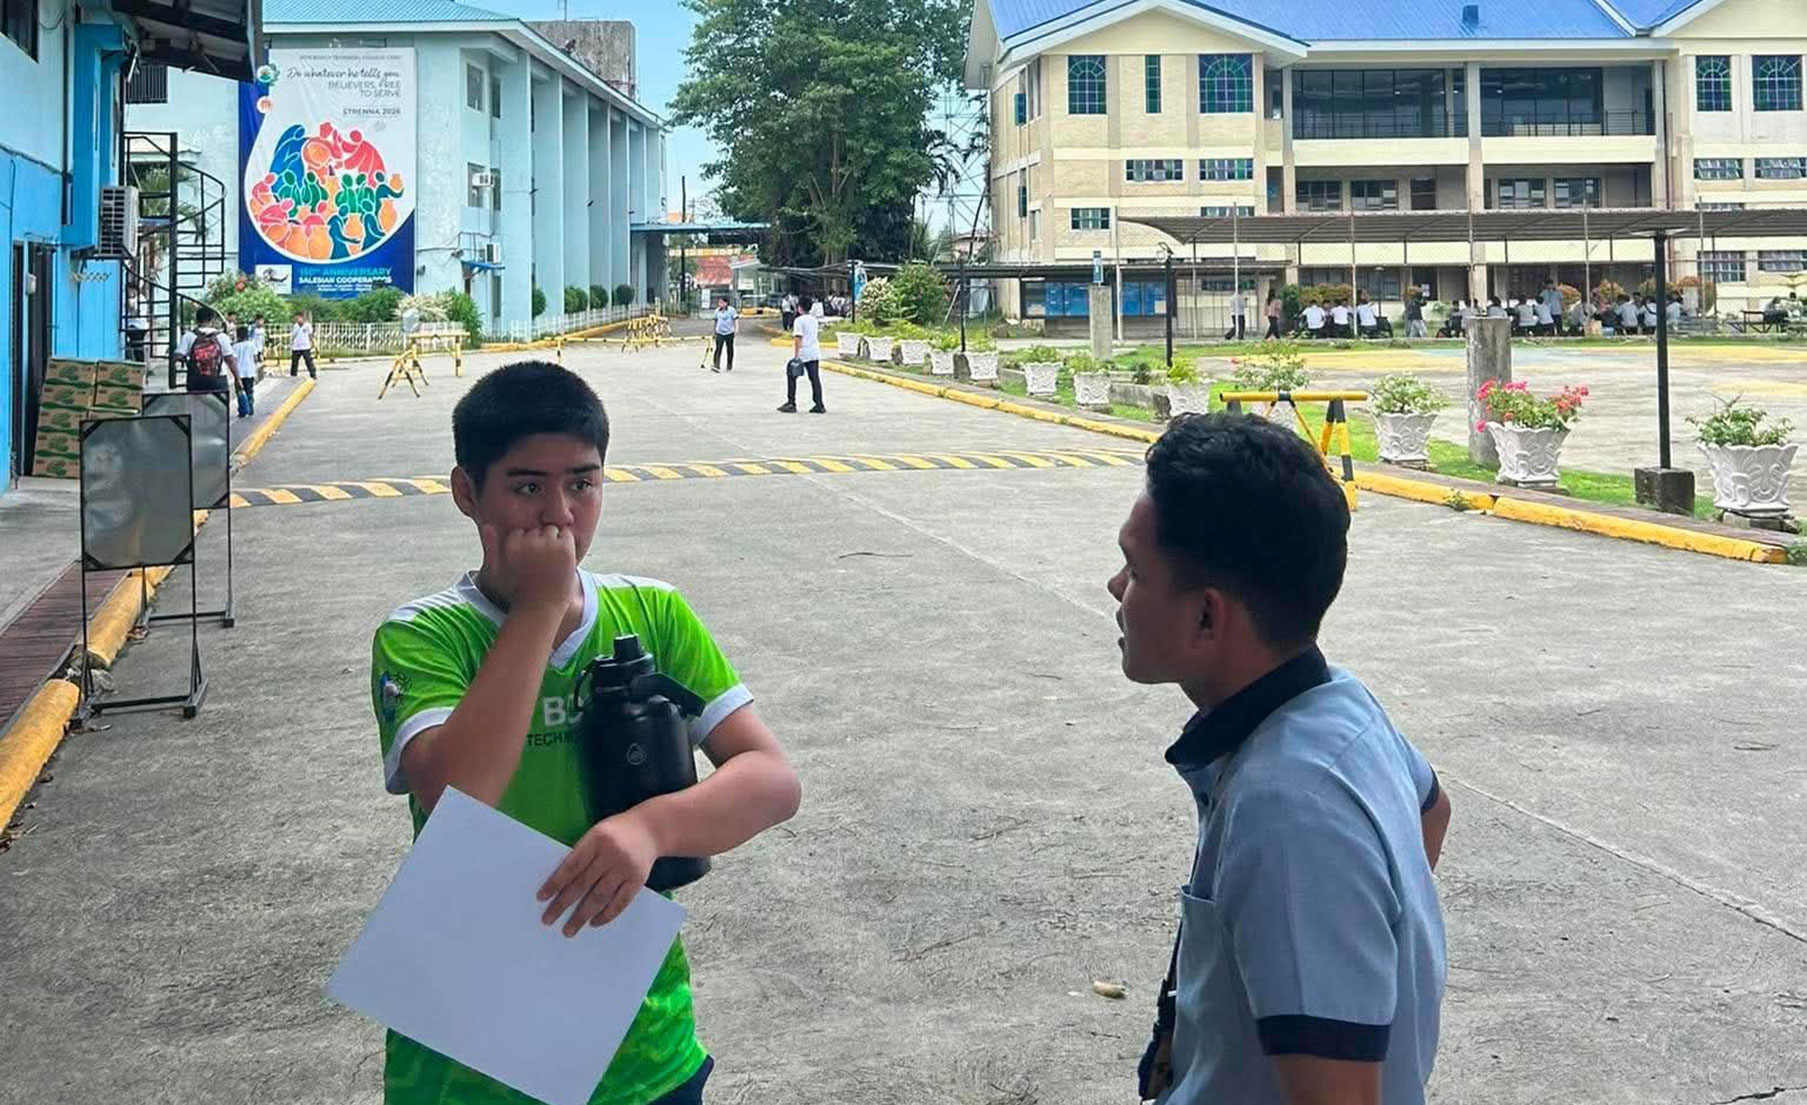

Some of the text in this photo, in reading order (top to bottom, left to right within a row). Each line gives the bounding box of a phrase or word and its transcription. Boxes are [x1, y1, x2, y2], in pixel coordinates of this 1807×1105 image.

[286, 66, 400, 82] Do whatever he tells you
[360, 89, 401, 97] TO SERVE
[323, 267, 392, 276] ANNIVERSARY
[298, 276, 335, 284] SALESIAN
